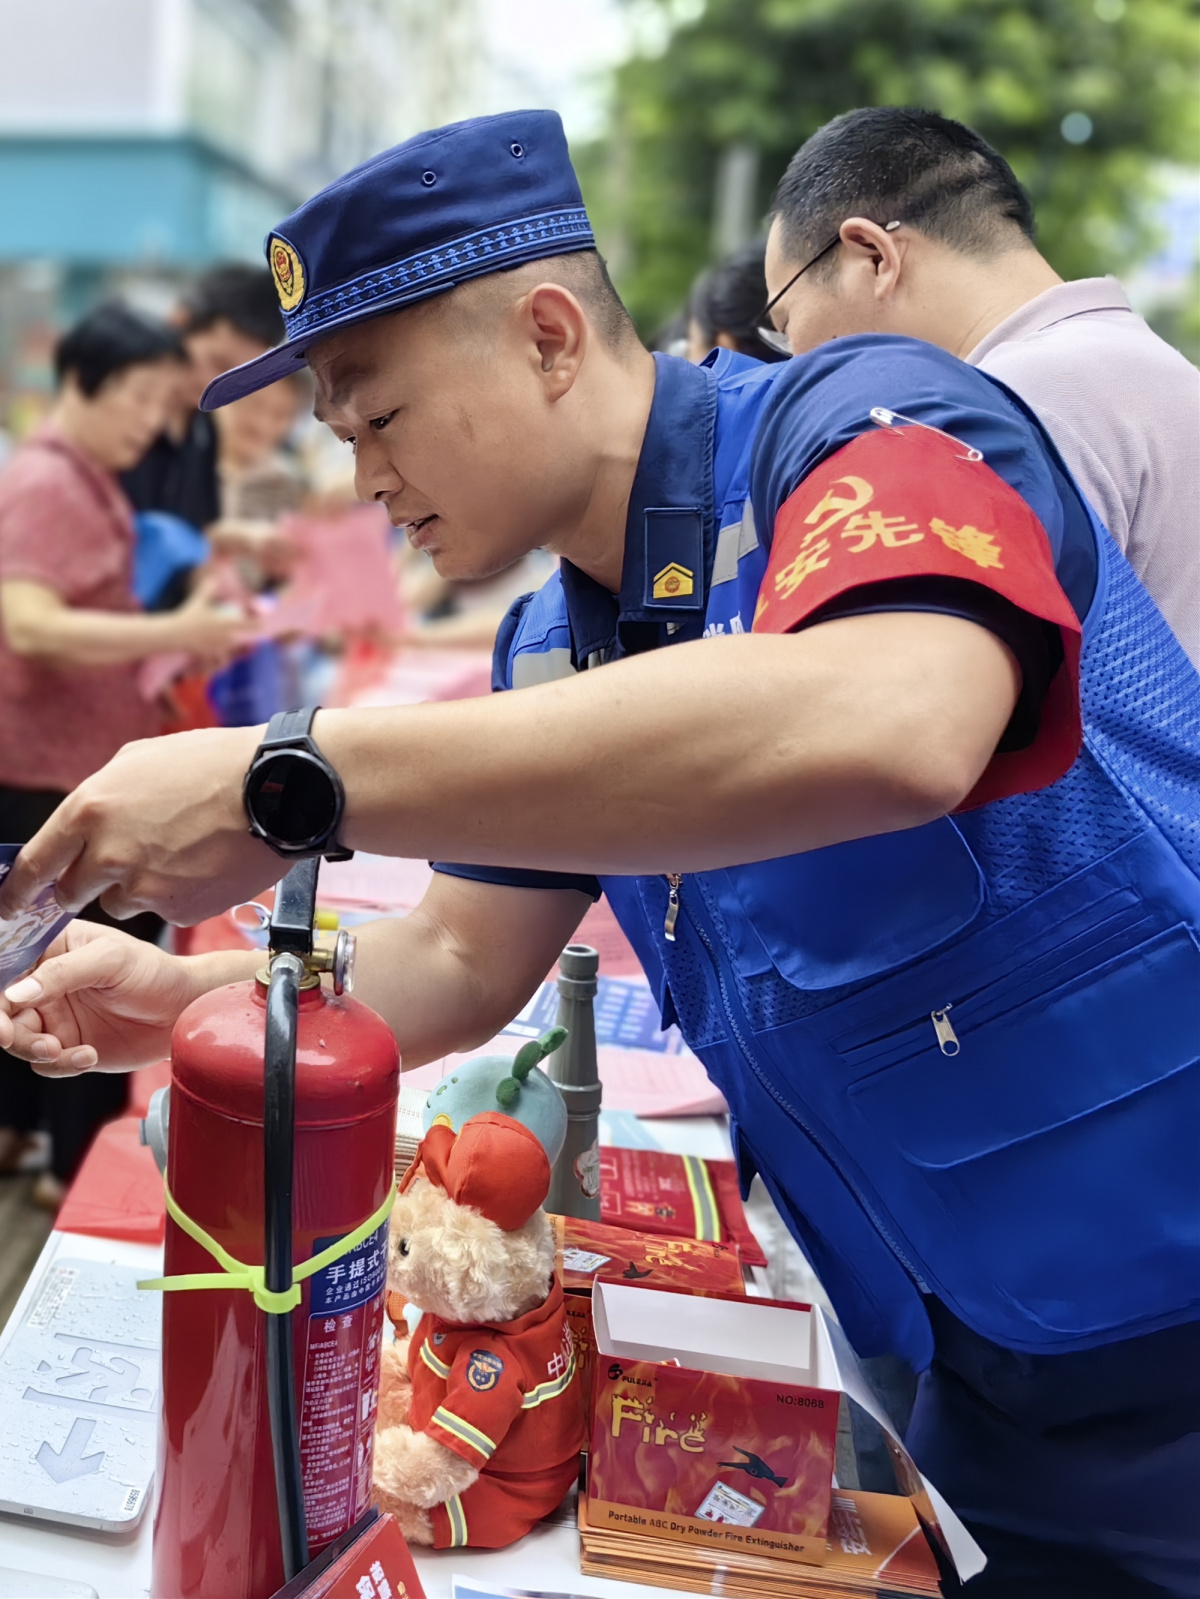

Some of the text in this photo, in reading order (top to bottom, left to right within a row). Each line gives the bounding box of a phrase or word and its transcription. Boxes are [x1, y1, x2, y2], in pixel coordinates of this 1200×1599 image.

[324, 1314, 353, 1333] 检查
[611, 1394, 708, 1453] Fire
[608, 1510, 804, 1553] Portable ABC Dry Powder Fire Extinguisher
